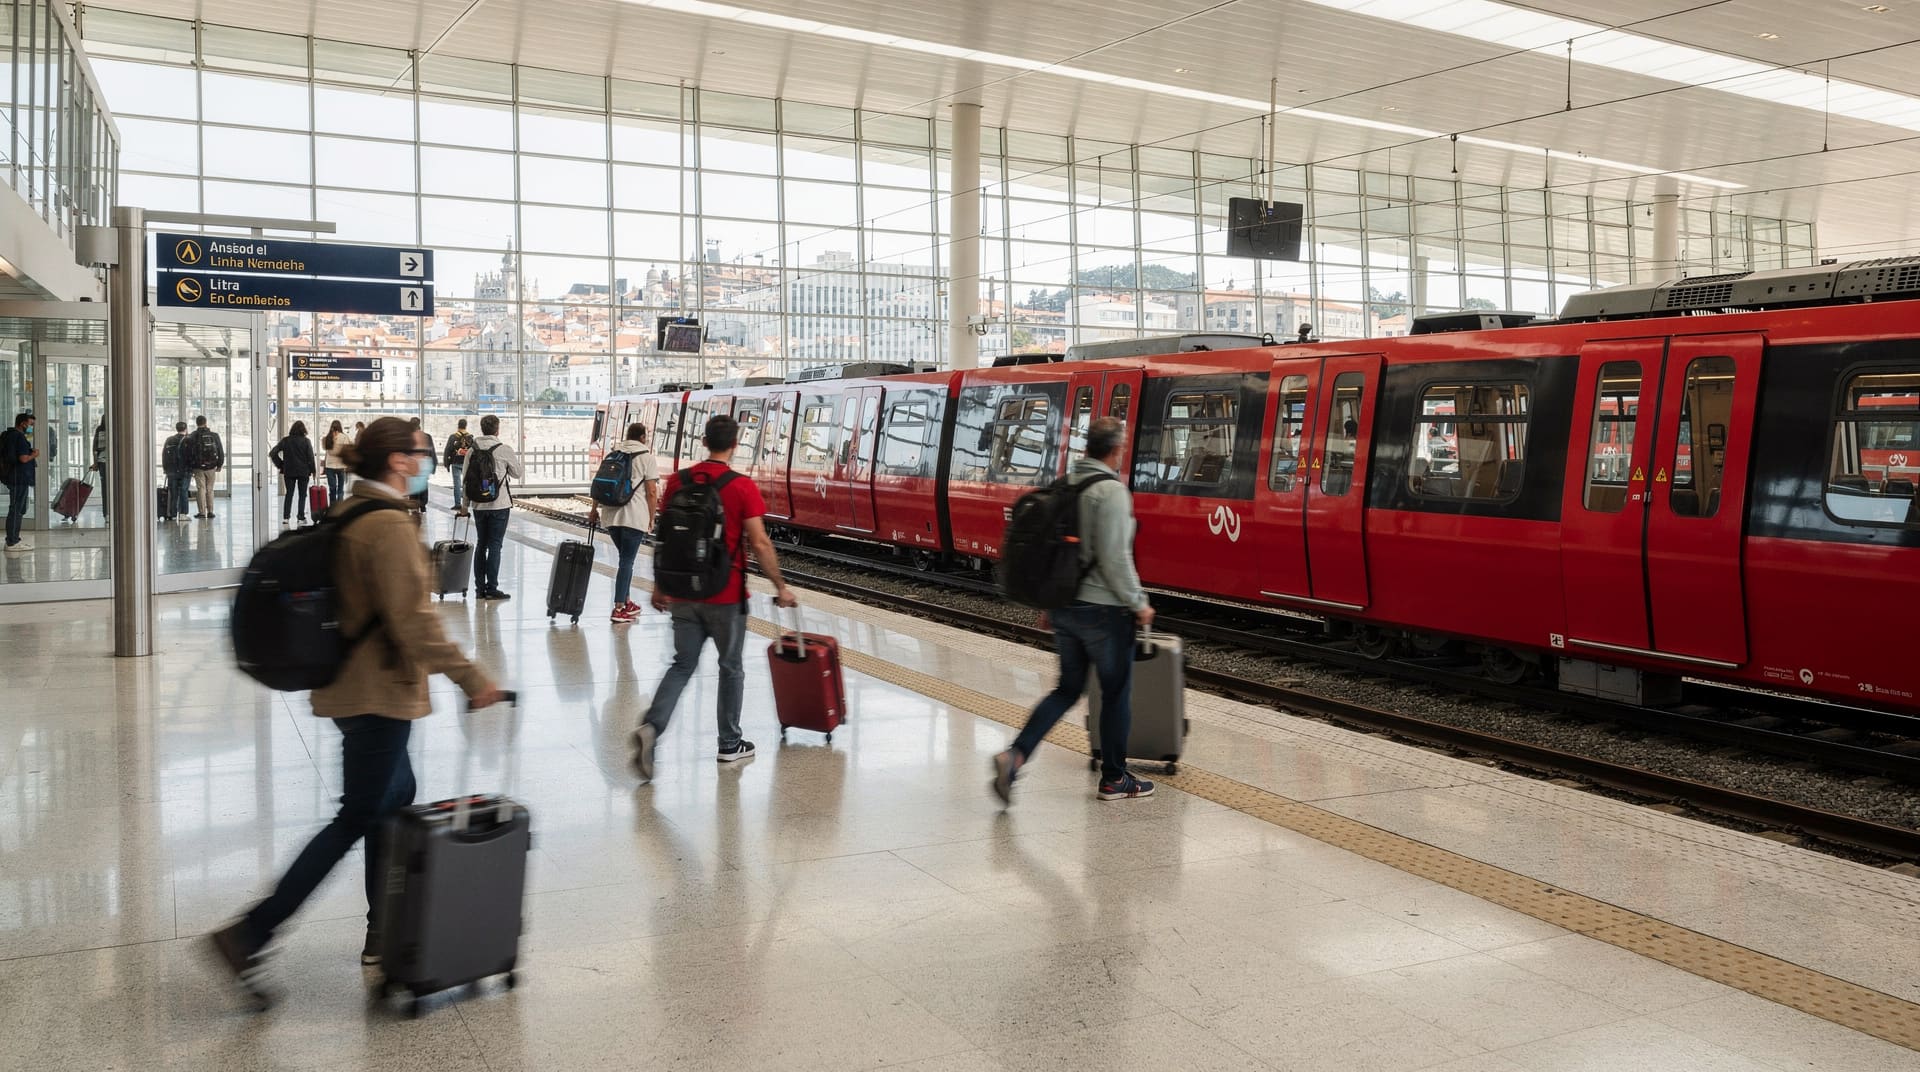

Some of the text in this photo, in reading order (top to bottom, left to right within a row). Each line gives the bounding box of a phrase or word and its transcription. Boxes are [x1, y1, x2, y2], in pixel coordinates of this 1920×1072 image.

[210, 255, 244, 268] Linha
[210, 278, 240, 291] Litra
[210, 292, 225, 304] En
